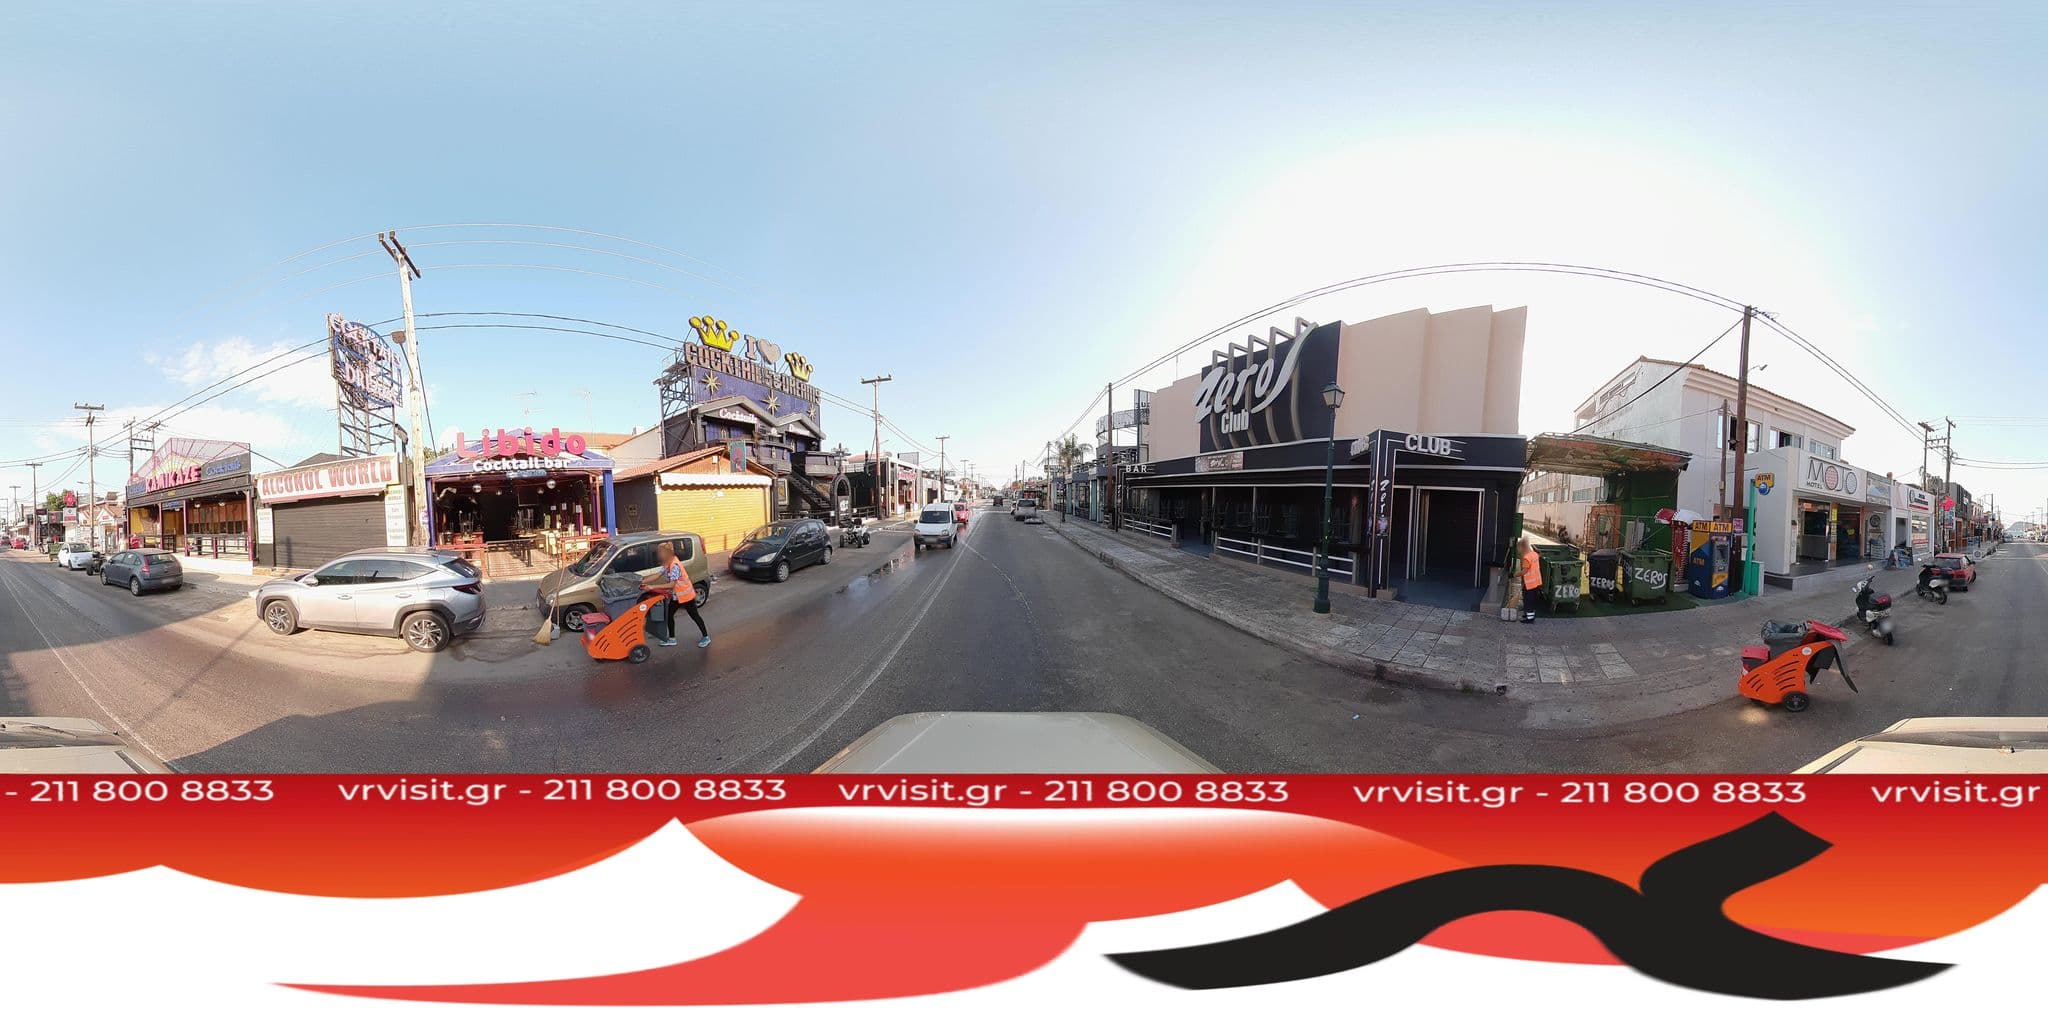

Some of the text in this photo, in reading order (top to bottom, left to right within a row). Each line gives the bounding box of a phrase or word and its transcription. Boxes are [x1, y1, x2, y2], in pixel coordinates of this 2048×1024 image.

[456, 426, 586, 459] Libido
[1405, 434, 1451, 456] CLUB
[472, 456, 536, 473] Cocktail
[1126, 464, 1147, 473] BAR
[146, 464, 202, 494] KAMIKAZE
[262, 459, 392, 496] ALCOHOL WORLD
[1757, 473, 1772, 482] ATM
[1695, 521, 1708, 531] ATM
[1714, 523, 1728, 533] ATM
[1634, 567, 1668, 589] ZEROS
